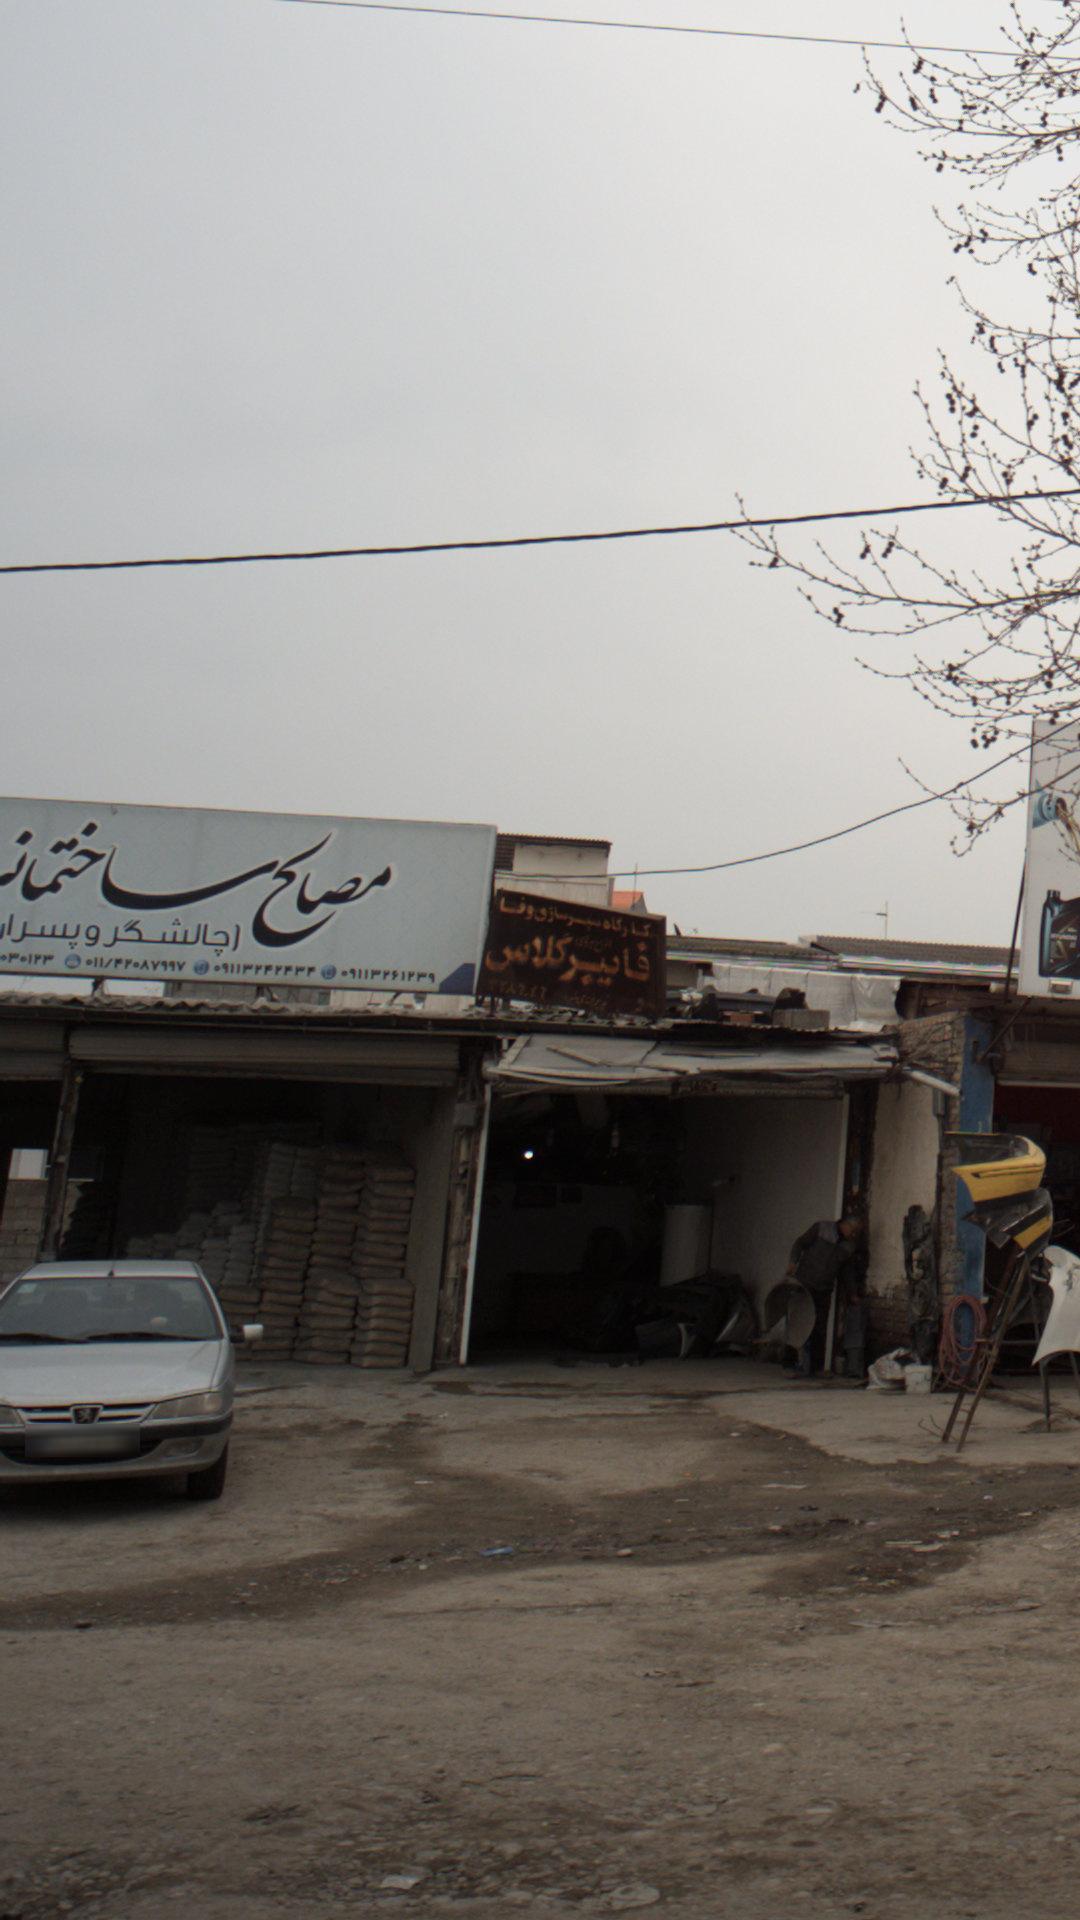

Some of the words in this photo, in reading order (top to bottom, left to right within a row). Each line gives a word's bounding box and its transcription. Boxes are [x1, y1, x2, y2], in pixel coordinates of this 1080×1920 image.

[0, 822, 279, 910] ساختمان
[252, 832, 392, 948] مصالح
[84, 924, 101, 947] و
[86, 957, 186, 972] ۰۱۱/۴۲۰۸۷۹۹۷
